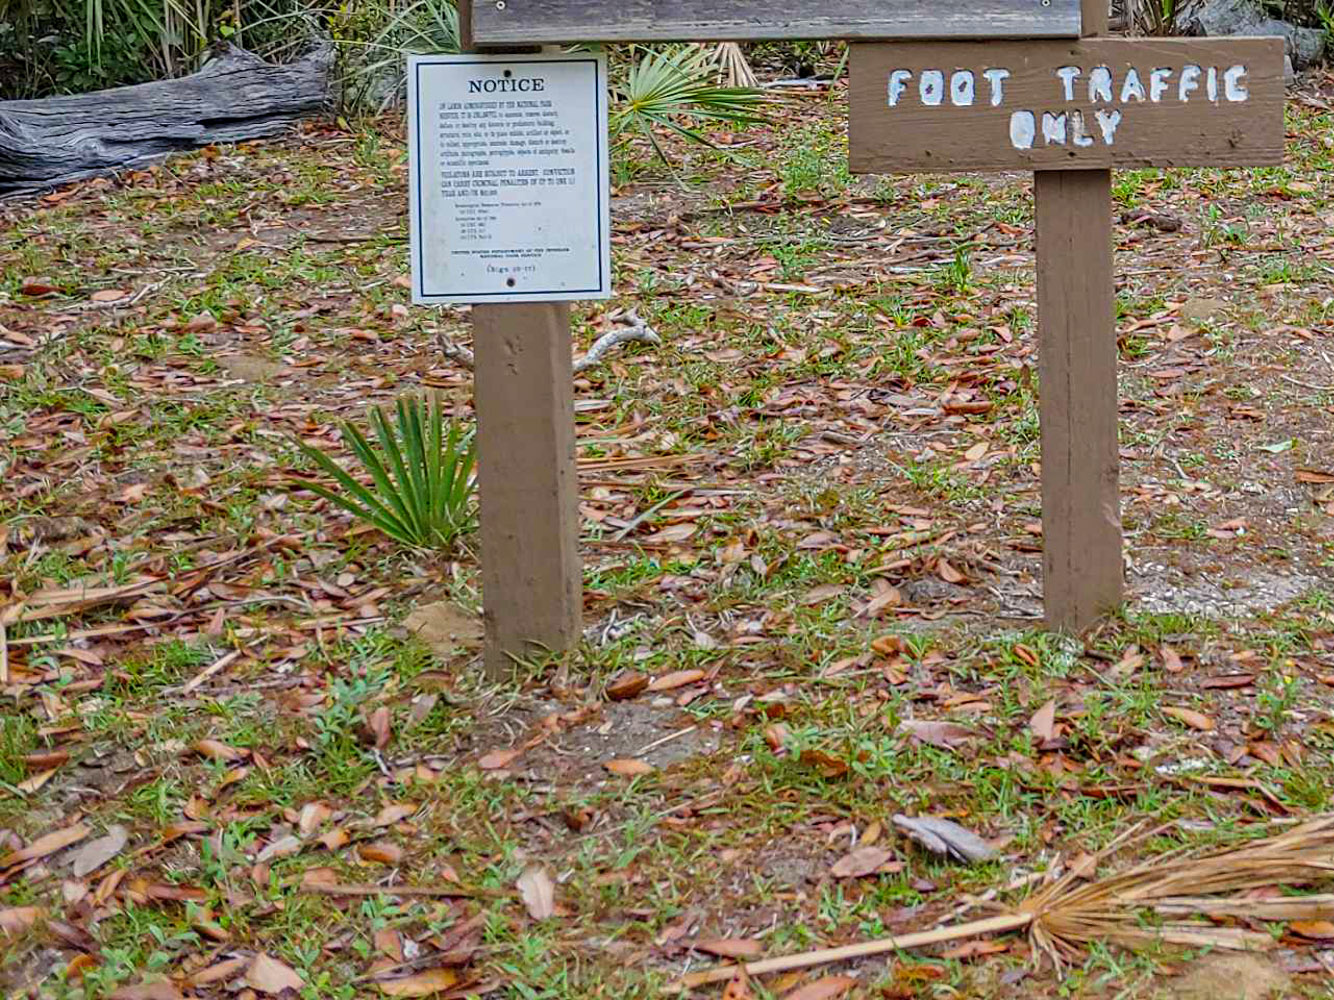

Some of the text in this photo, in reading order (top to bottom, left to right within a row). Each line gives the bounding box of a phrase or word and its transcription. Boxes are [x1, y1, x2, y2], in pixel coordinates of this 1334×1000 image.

[468, 78, 545, 93] NOTICE
[887, 63, 1249, 108] FOOT TRAFFIC
[1008, 109, 1122, 150] ONLY
